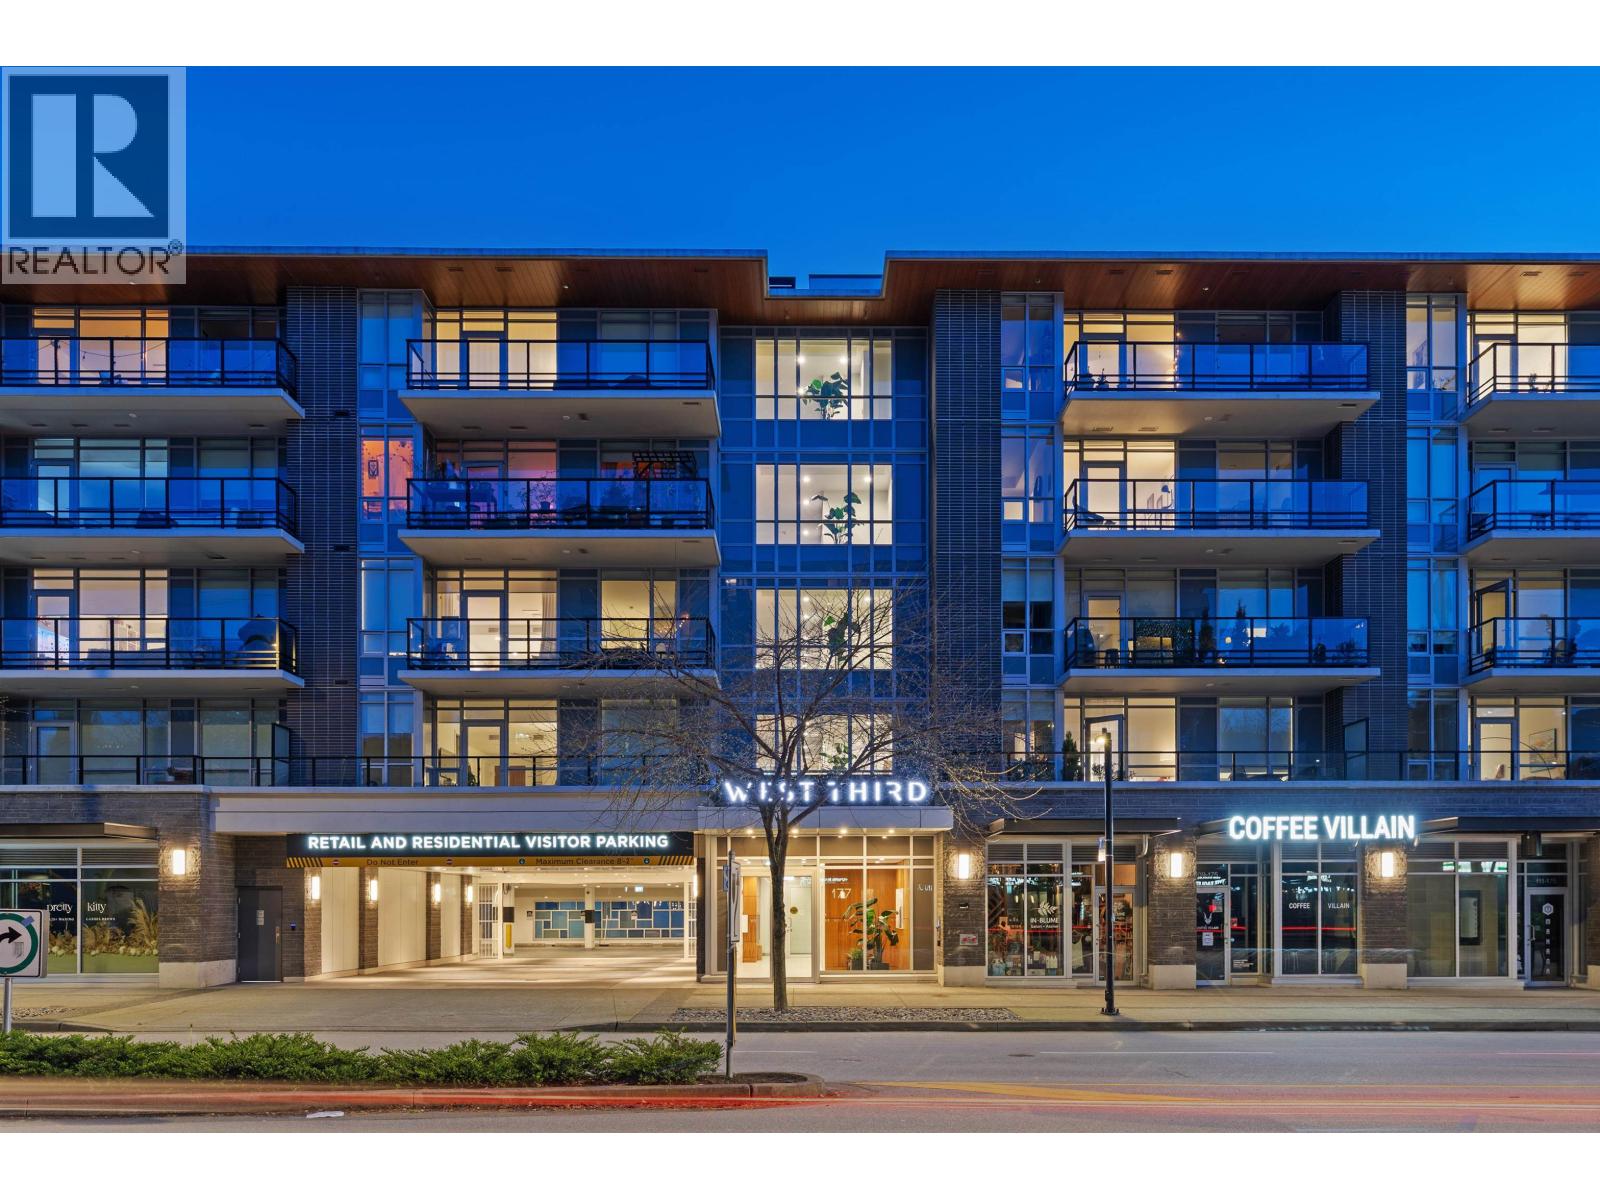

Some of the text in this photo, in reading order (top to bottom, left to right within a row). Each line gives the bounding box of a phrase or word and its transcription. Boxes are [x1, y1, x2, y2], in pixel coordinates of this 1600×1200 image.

[827, 781, 928, 802] THIRD
[1229, 815, 1415, 840] COFFEE VILLAIN
[308, 835, 669, 849] RETAIL AND RESIDENTIAL VISITOR PARKING
[366, 858, 419, 866] Do Not Enter
[576, 857, 615, 865] Clearance
[46, 902, 107, 913] pretty kitty
